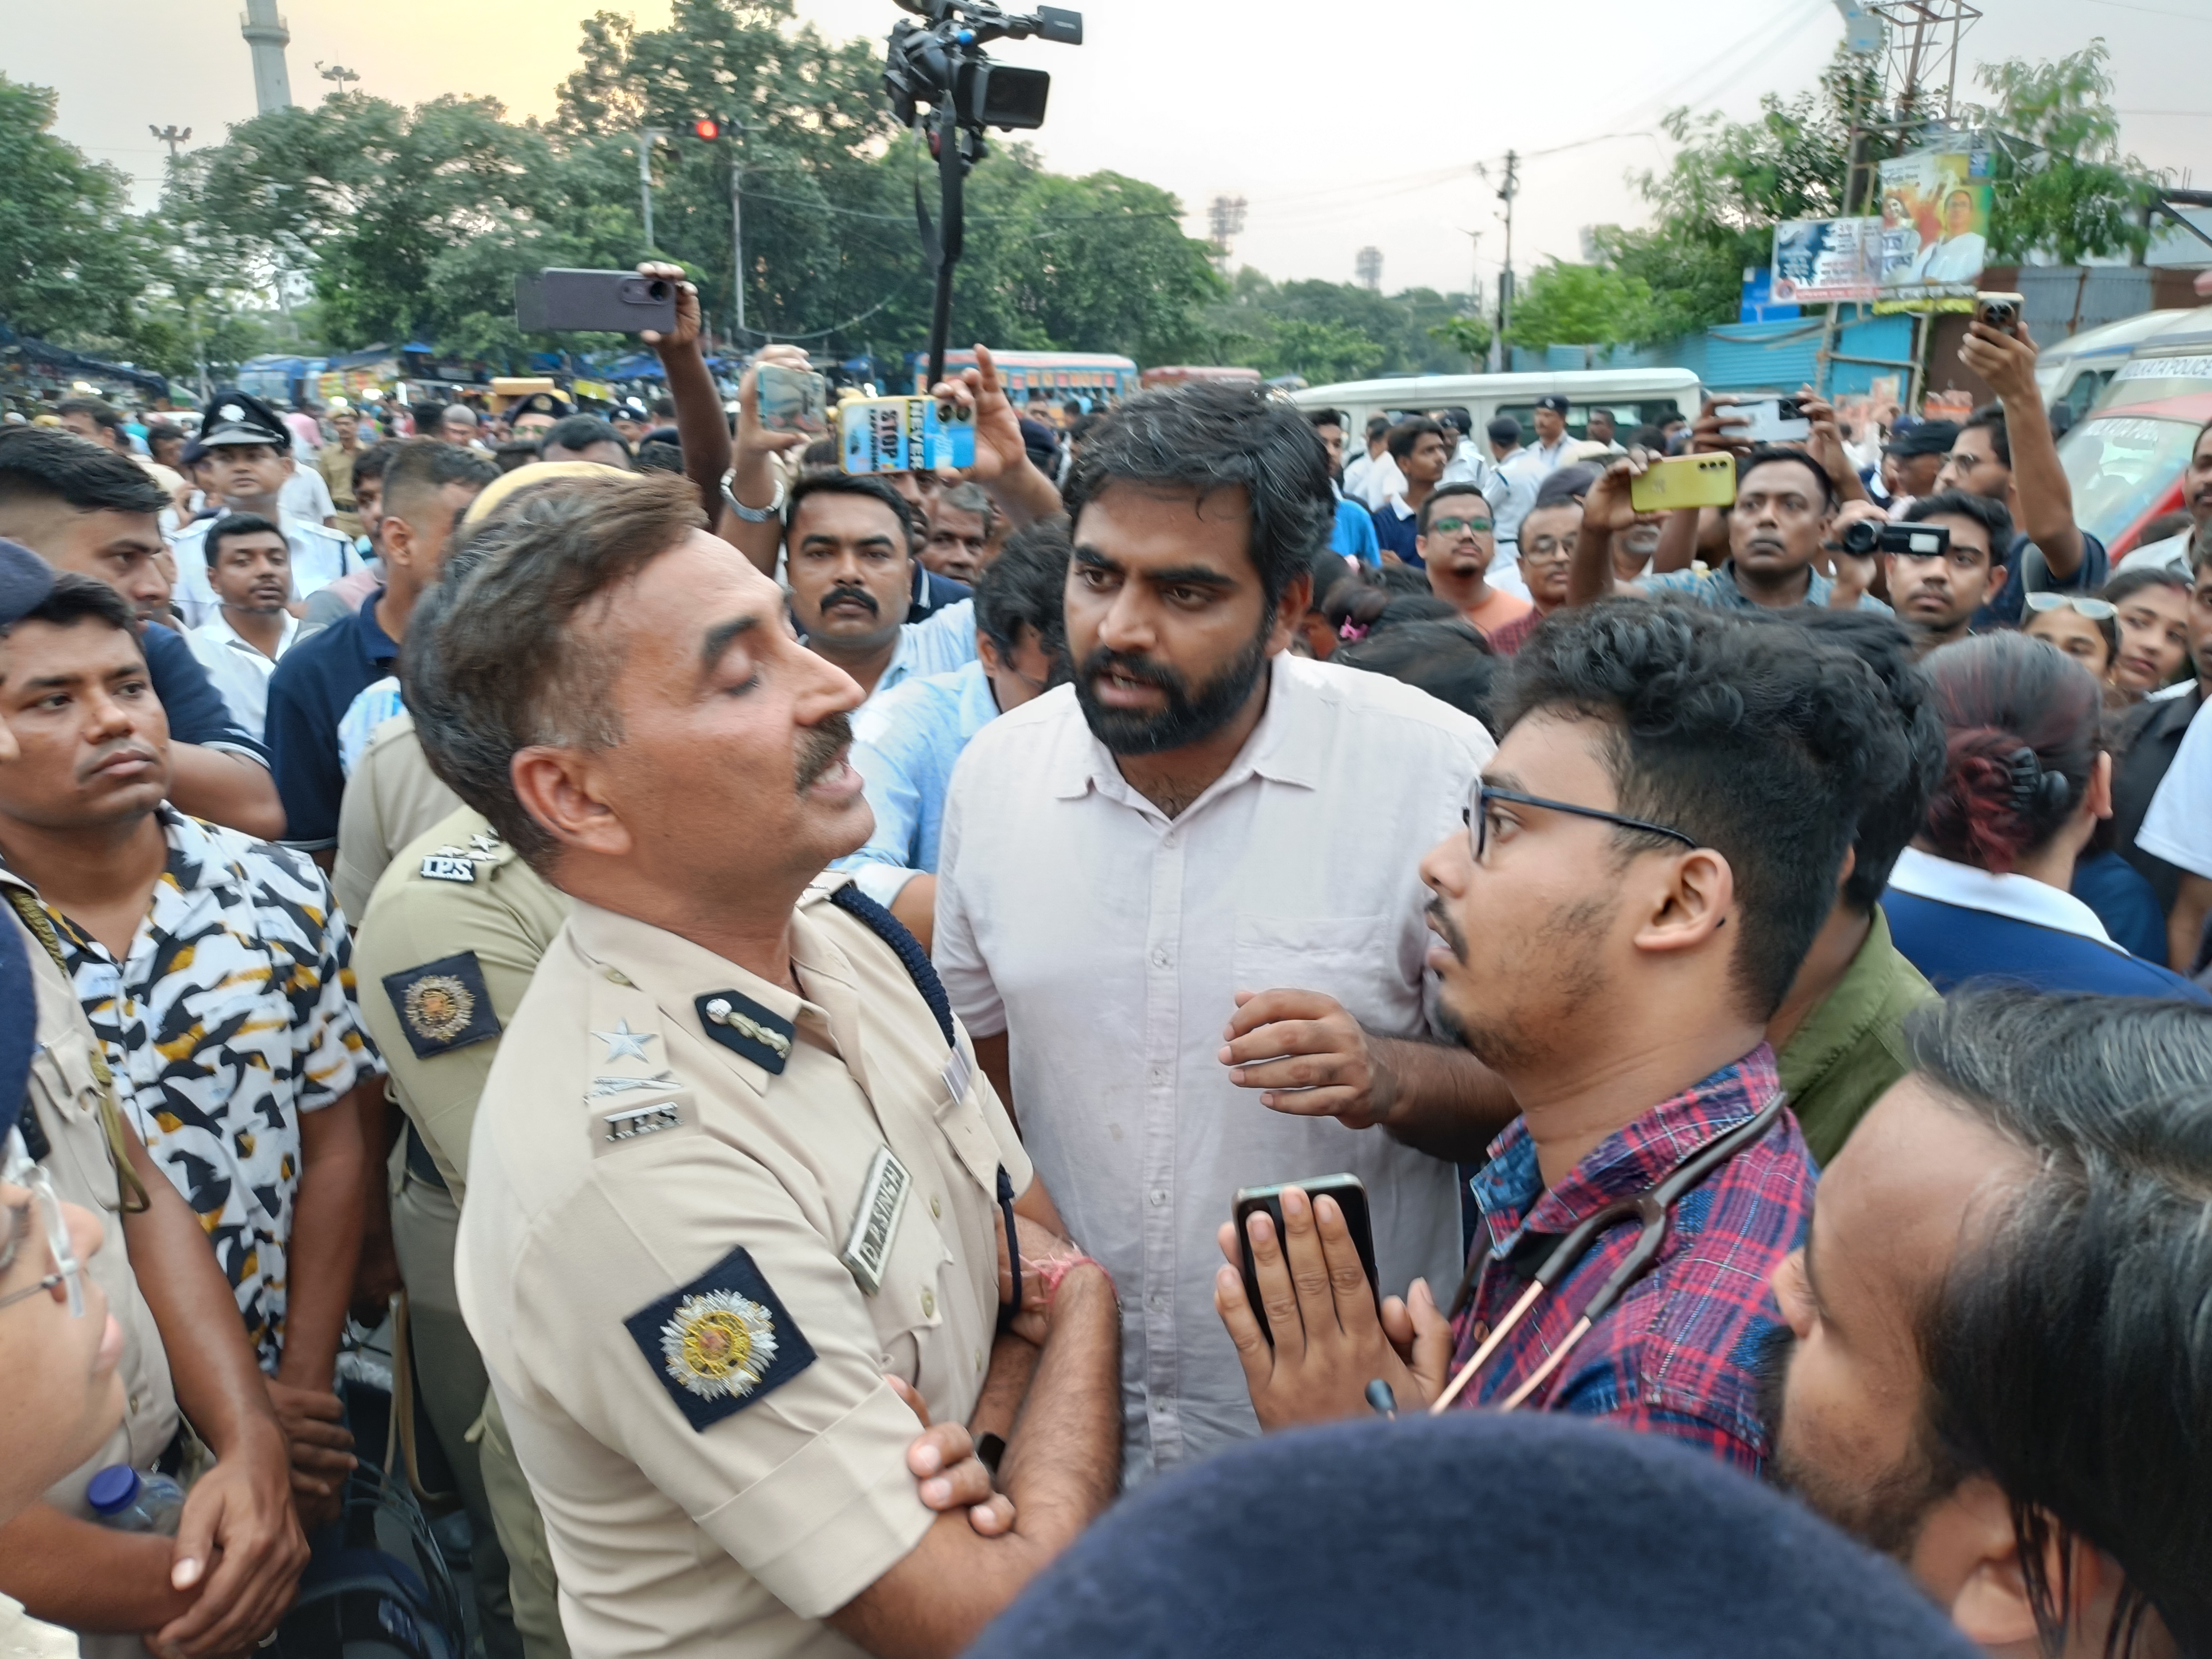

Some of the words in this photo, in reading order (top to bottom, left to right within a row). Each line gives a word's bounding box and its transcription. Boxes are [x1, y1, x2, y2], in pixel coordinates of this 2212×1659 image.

[881, 409, 898, 459] STOP
[909, 401, 925, 471] NEVER
[873, 1164, 902, 1228] SINGH
